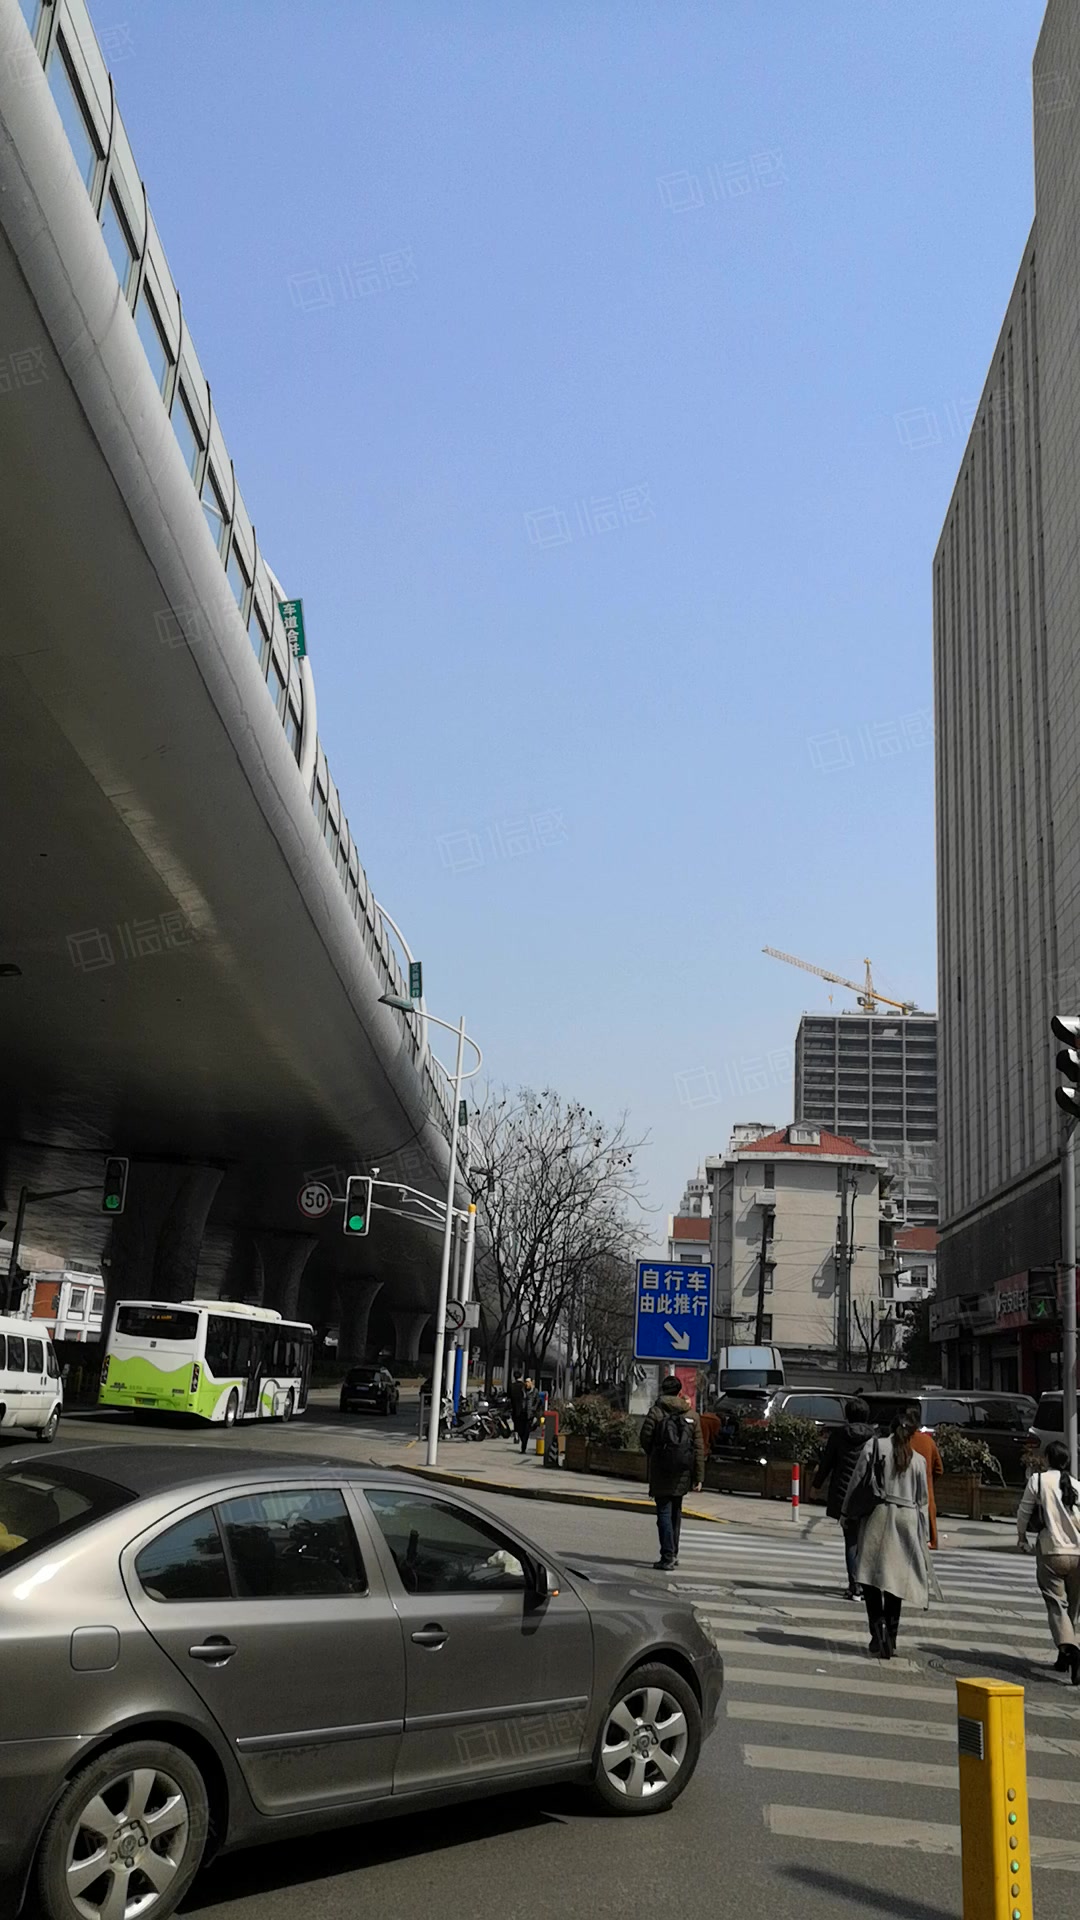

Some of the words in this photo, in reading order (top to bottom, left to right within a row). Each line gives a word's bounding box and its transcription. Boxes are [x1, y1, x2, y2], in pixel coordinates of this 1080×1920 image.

[305, 1191, 325, 1208] 50
[642, 1268, 707, 1292] 自行车
[639, 1292, 708, 1317] 由此推行
